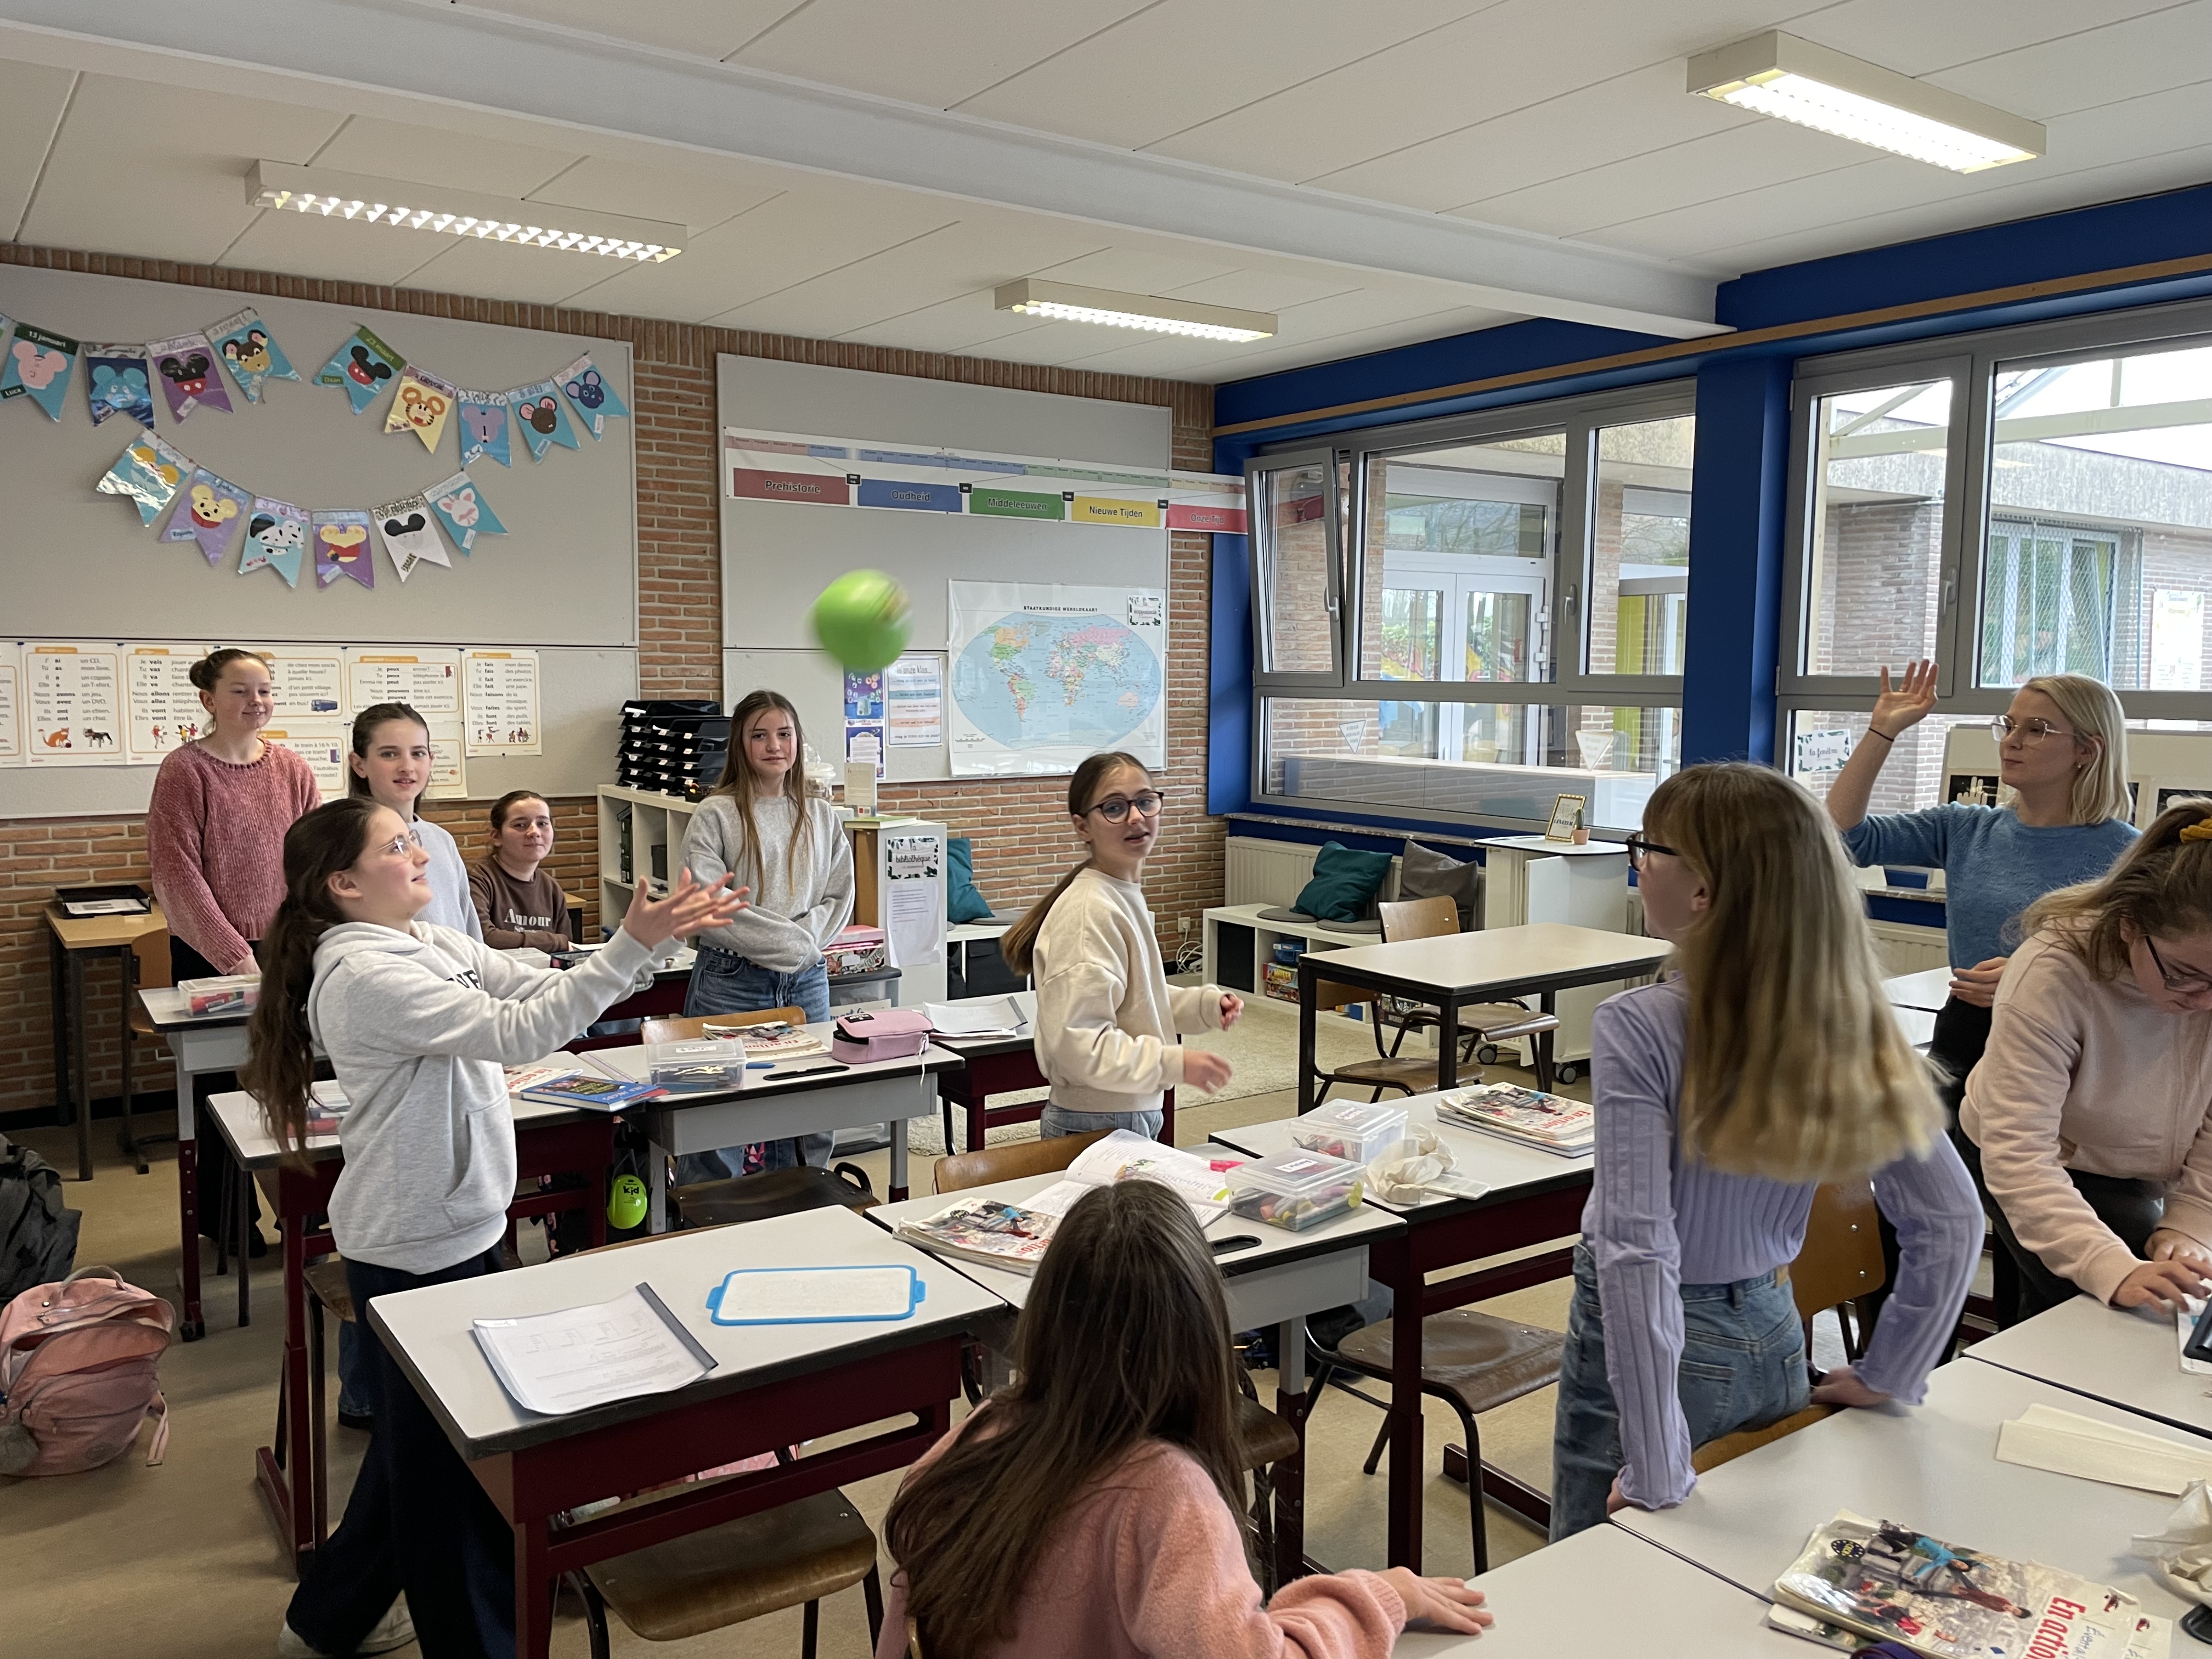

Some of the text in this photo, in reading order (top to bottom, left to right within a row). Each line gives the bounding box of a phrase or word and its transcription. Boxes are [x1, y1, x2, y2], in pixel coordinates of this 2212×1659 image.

[765, 480, 821, 494] Prehistorie
[891, 490, 930, 501] Oudheid
[988, 497, 1047, 511] Middeleeuwen
[1089, 506, 1143, 518] Nieuwe Tijden
[1190, 514, 1224, 524] Onze Tijd
[895, 854, 931, 865] bibliothèque
[504, 908, 551, 927] Amour
[623, 1186, 639, 1195] kid
[2047, 1596, 2086, 1620] En
